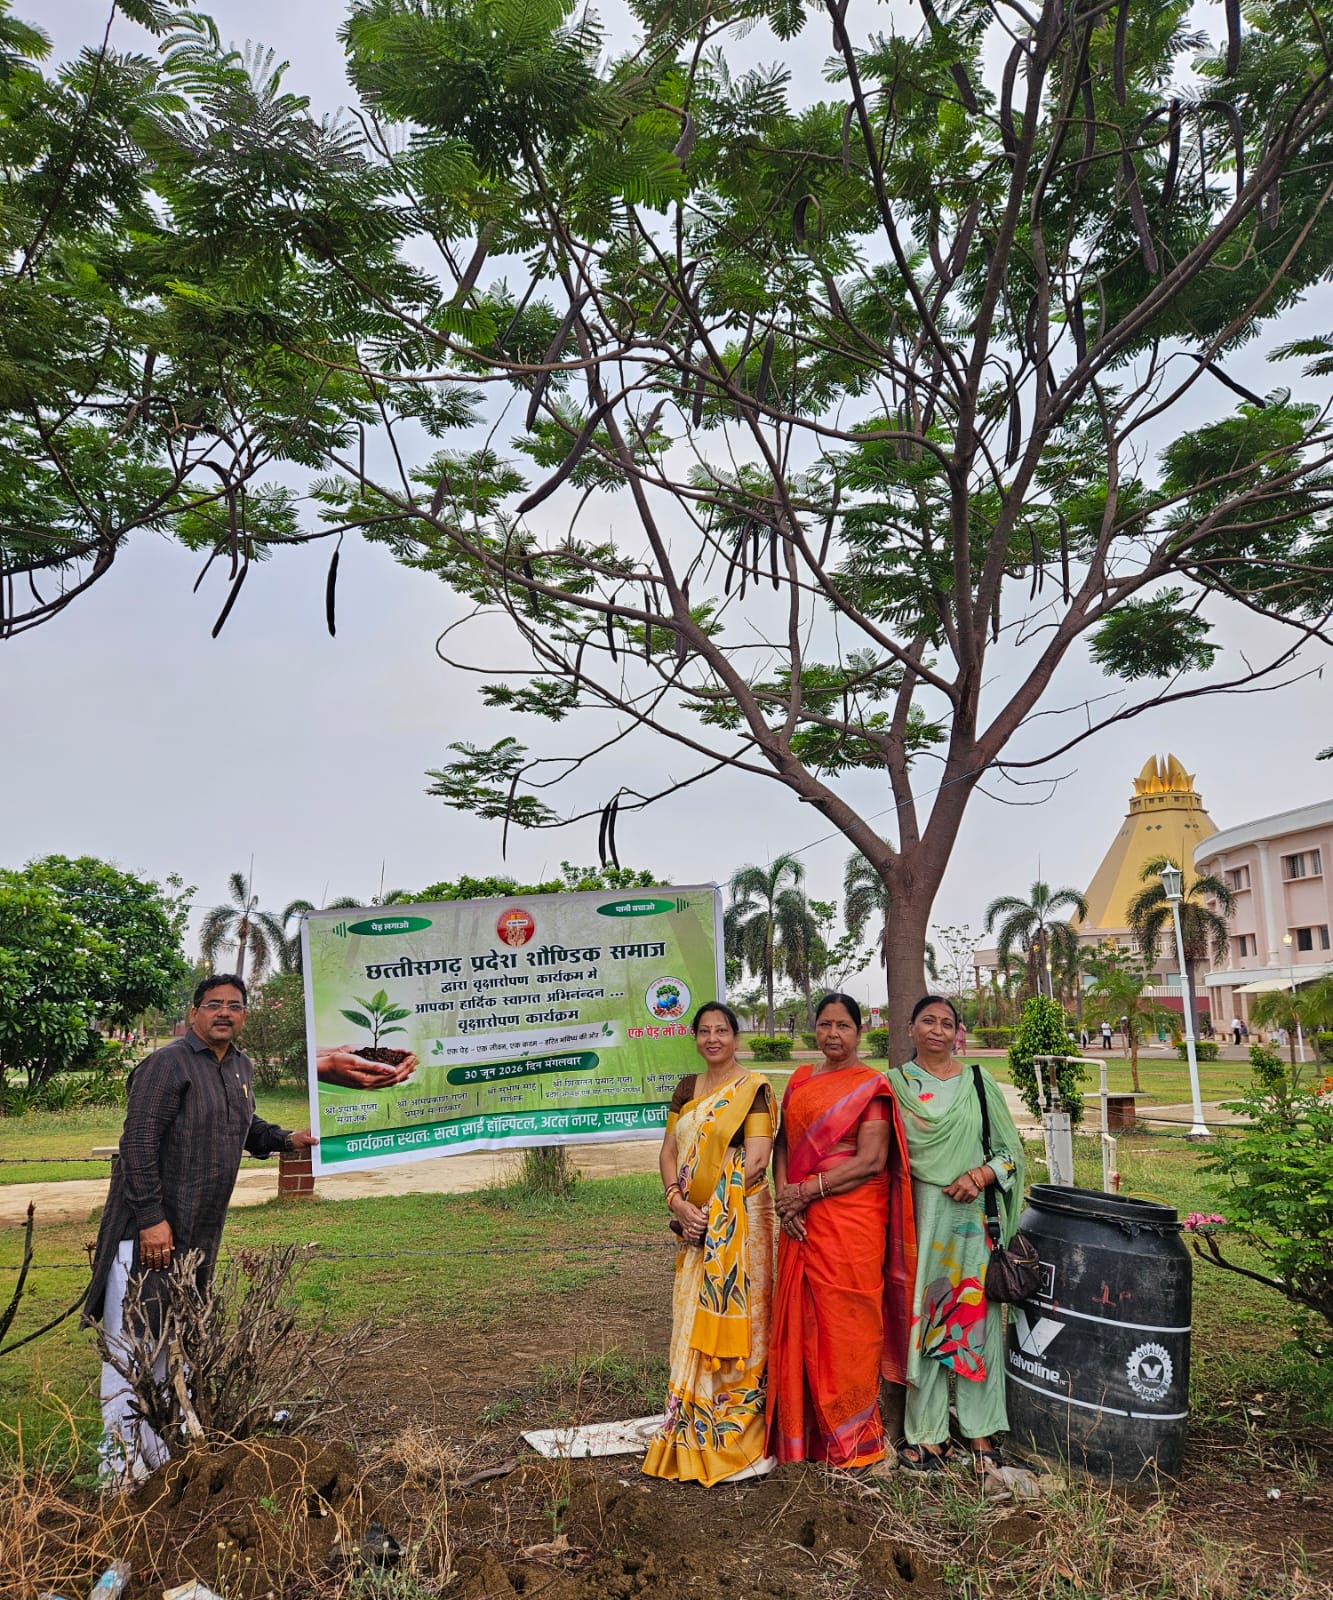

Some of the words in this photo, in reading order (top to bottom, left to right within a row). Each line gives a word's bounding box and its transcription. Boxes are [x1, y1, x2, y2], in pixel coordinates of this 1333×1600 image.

[616, 903, 631, 912] पानी
[371, 922, 382, 932] पेड़
[384, 920, 409, 930] लगाओ
[365, 957, 462, 979] छत्तीसगढ़
[471, 949, 517, 972] प्रदेश
[526, 945, 601, 966] शौण्डिक
[610, 942, 665, 960] समाज
[440, 980, 467, 993] द्वारा
[473, 974, 529, 993] वृक्षारोपण
[536, 970, 584, 983] कार्यक्रम
[415, 1001, 454, 1013] आपका
[459, 995, 497, 1010] हार्दिक
[502, 992, 541, 1006] स्वागत
[457, 1013, 520, 1033] वृक्षारोपण
[526, 1008, 579, 1024] कार्यक्रम
[628, 1027, 644, 1038] एक
[647, 1024, 660, 1039] पेड़
[662, 1022, 675, 1036] माँ
[677, 1024, 687, 1036] के
[465, 1070, 477, 1080] 30
[480, 1068, 496, 1079] जून
[499, 1065, 524, 1075] 2026
[525, 1061, 542, 1071] दिन
[544, 1057, 582, 1068] मंगलवार
[325, 1105, 335, 1114] श्री
[346, 1134, 395, 1153] कार्यक्रम
[433, 1124, 459, 1140] सत्य
[485, 1115, 538, 1132] हॉस्पिटल,
[541, 1114, 569, 1128] अटल
[571, 1113, 601, 1127] नगर,
[603, 1110, 640, 1127] रायपुर
[642, 1105, 670, 1124] (छत्ती
[1138, 1347, 1169, 1360] QUALITY
[1009, 1349, 1061, 1383] Valvoline
